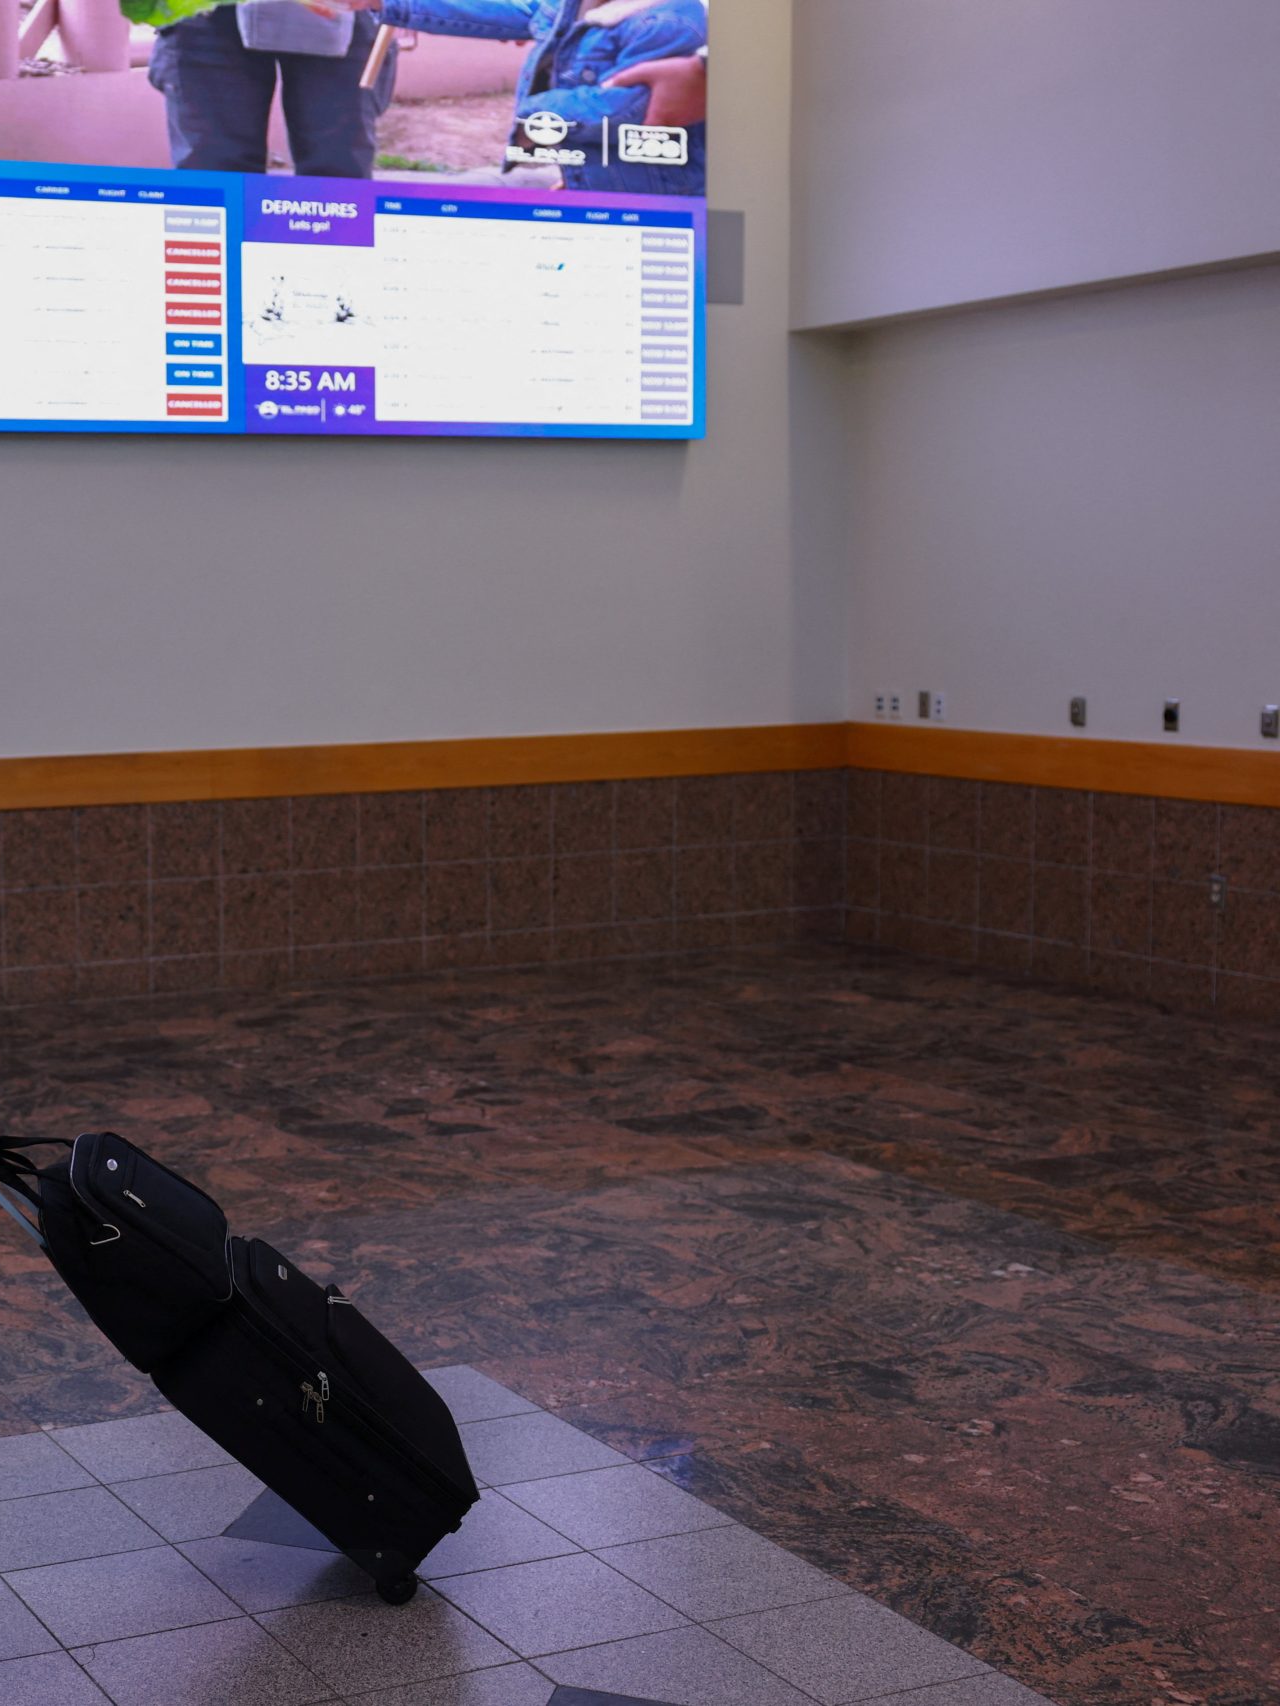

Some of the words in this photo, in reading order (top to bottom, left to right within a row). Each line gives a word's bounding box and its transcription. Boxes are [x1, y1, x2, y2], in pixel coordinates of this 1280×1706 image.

[533, 147, 586, 161] PASO
[627, 138, 682, 159] ZOO
[262, 199, 358, 219] DEPARTURES
[265, 369, 312, 391] 8:35
[317, 371, 356, 392] AM
